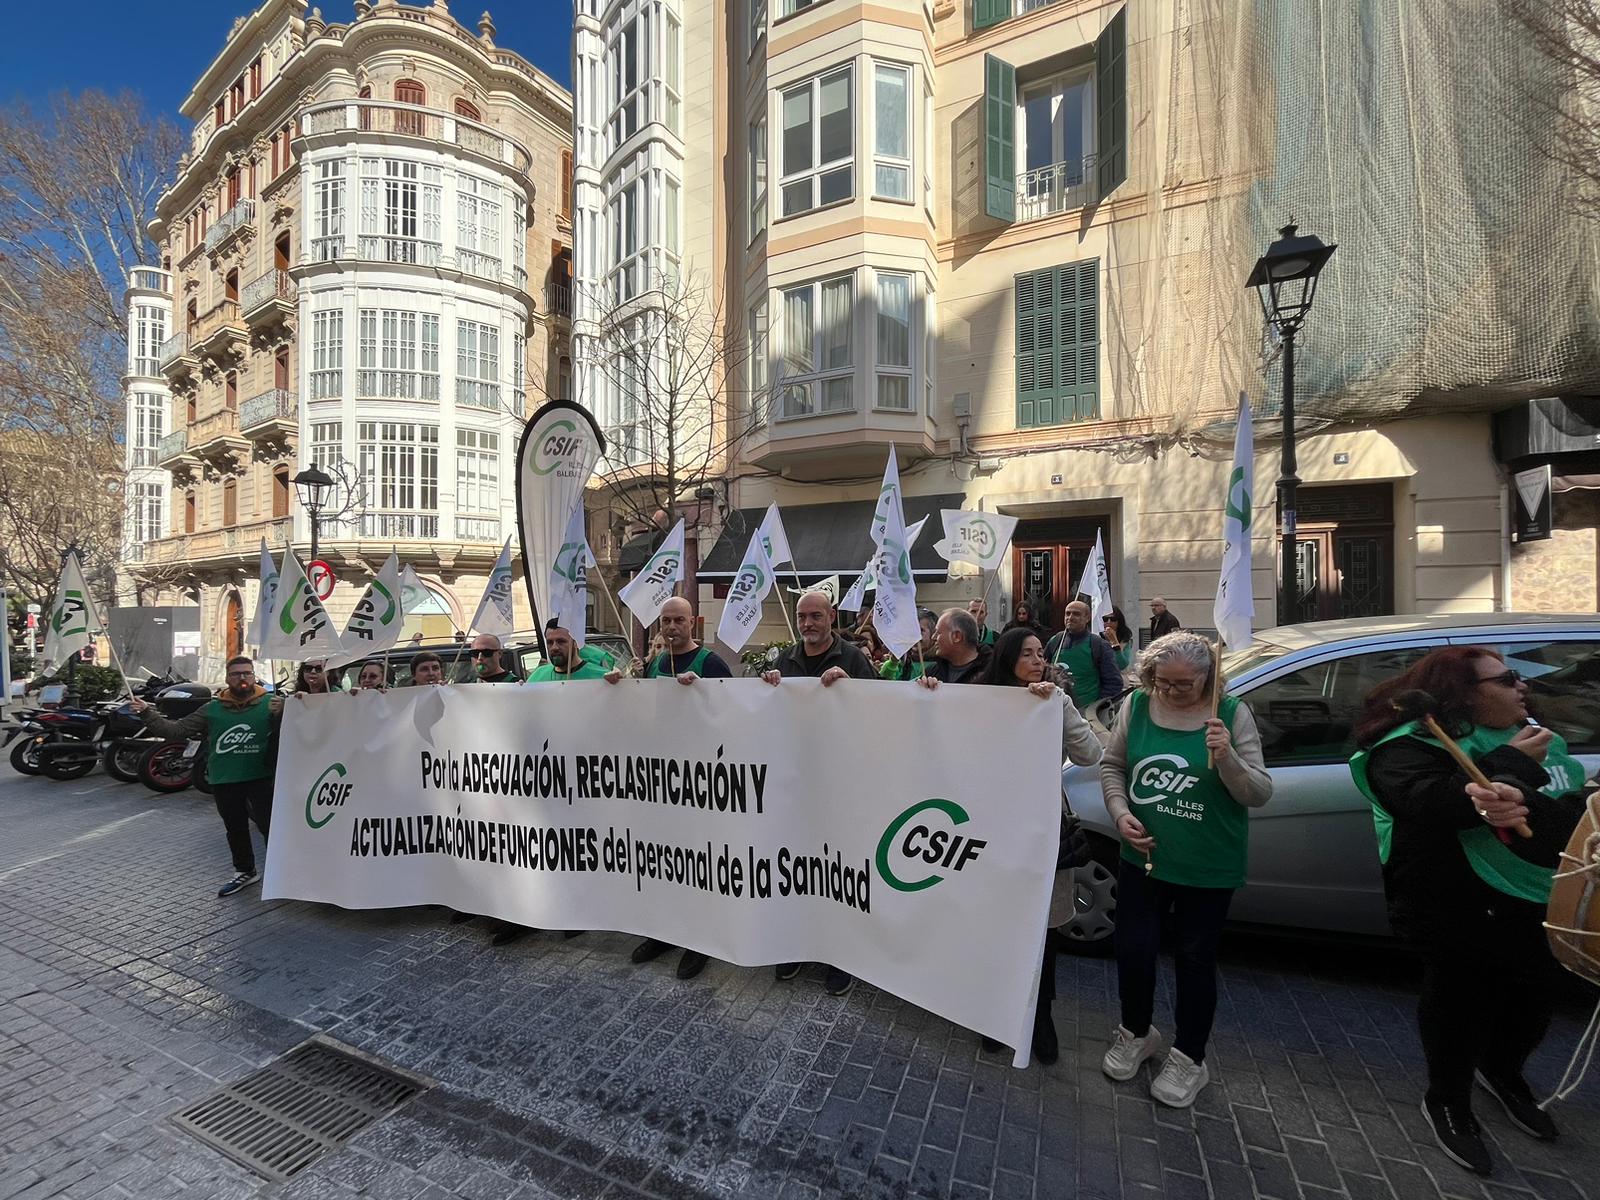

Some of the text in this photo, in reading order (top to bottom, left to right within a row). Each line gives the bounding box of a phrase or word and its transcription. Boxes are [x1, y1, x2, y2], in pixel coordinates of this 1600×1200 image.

[543, 436, 582, 456] CSIF
[223, 732, 257, 744] CSIF
[421, 738, 768, 814] Por la ADECUACIÓN, RECLASIFICACIÓN Y
[1141, 767, 1200, 794] CSIF
[316, 782, 353, 807] CSIF
[1176, 798, 1205, 812] ILLES
[1156, 803, 1203, 822] BALEARS
[350, 803, 871, 914] ACTUALIZACIÓN DE FUNCIONES del personal de la Sanidad
[902, 825, 988, 871] CSIF
